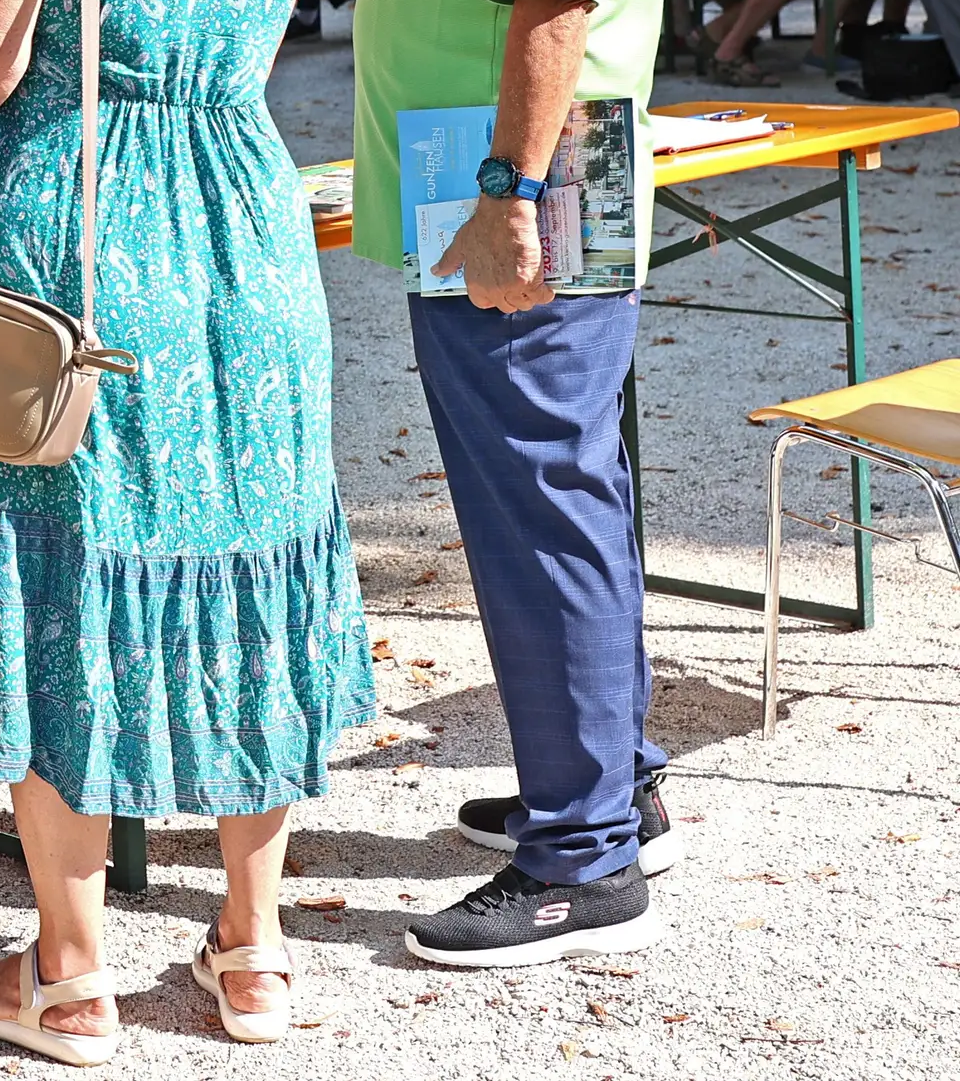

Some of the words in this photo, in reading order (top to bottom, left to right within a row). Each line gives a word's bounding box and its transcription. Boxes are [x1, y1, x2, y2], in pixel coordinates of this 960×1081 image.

[432, 127, 445, 172] HAUSEN
[422, 151, 436, 200] GUNZEN
[548, 195, 559, 235] September
[541, 236, 552, 274] 2023
[534, 901, 571, 926] S
